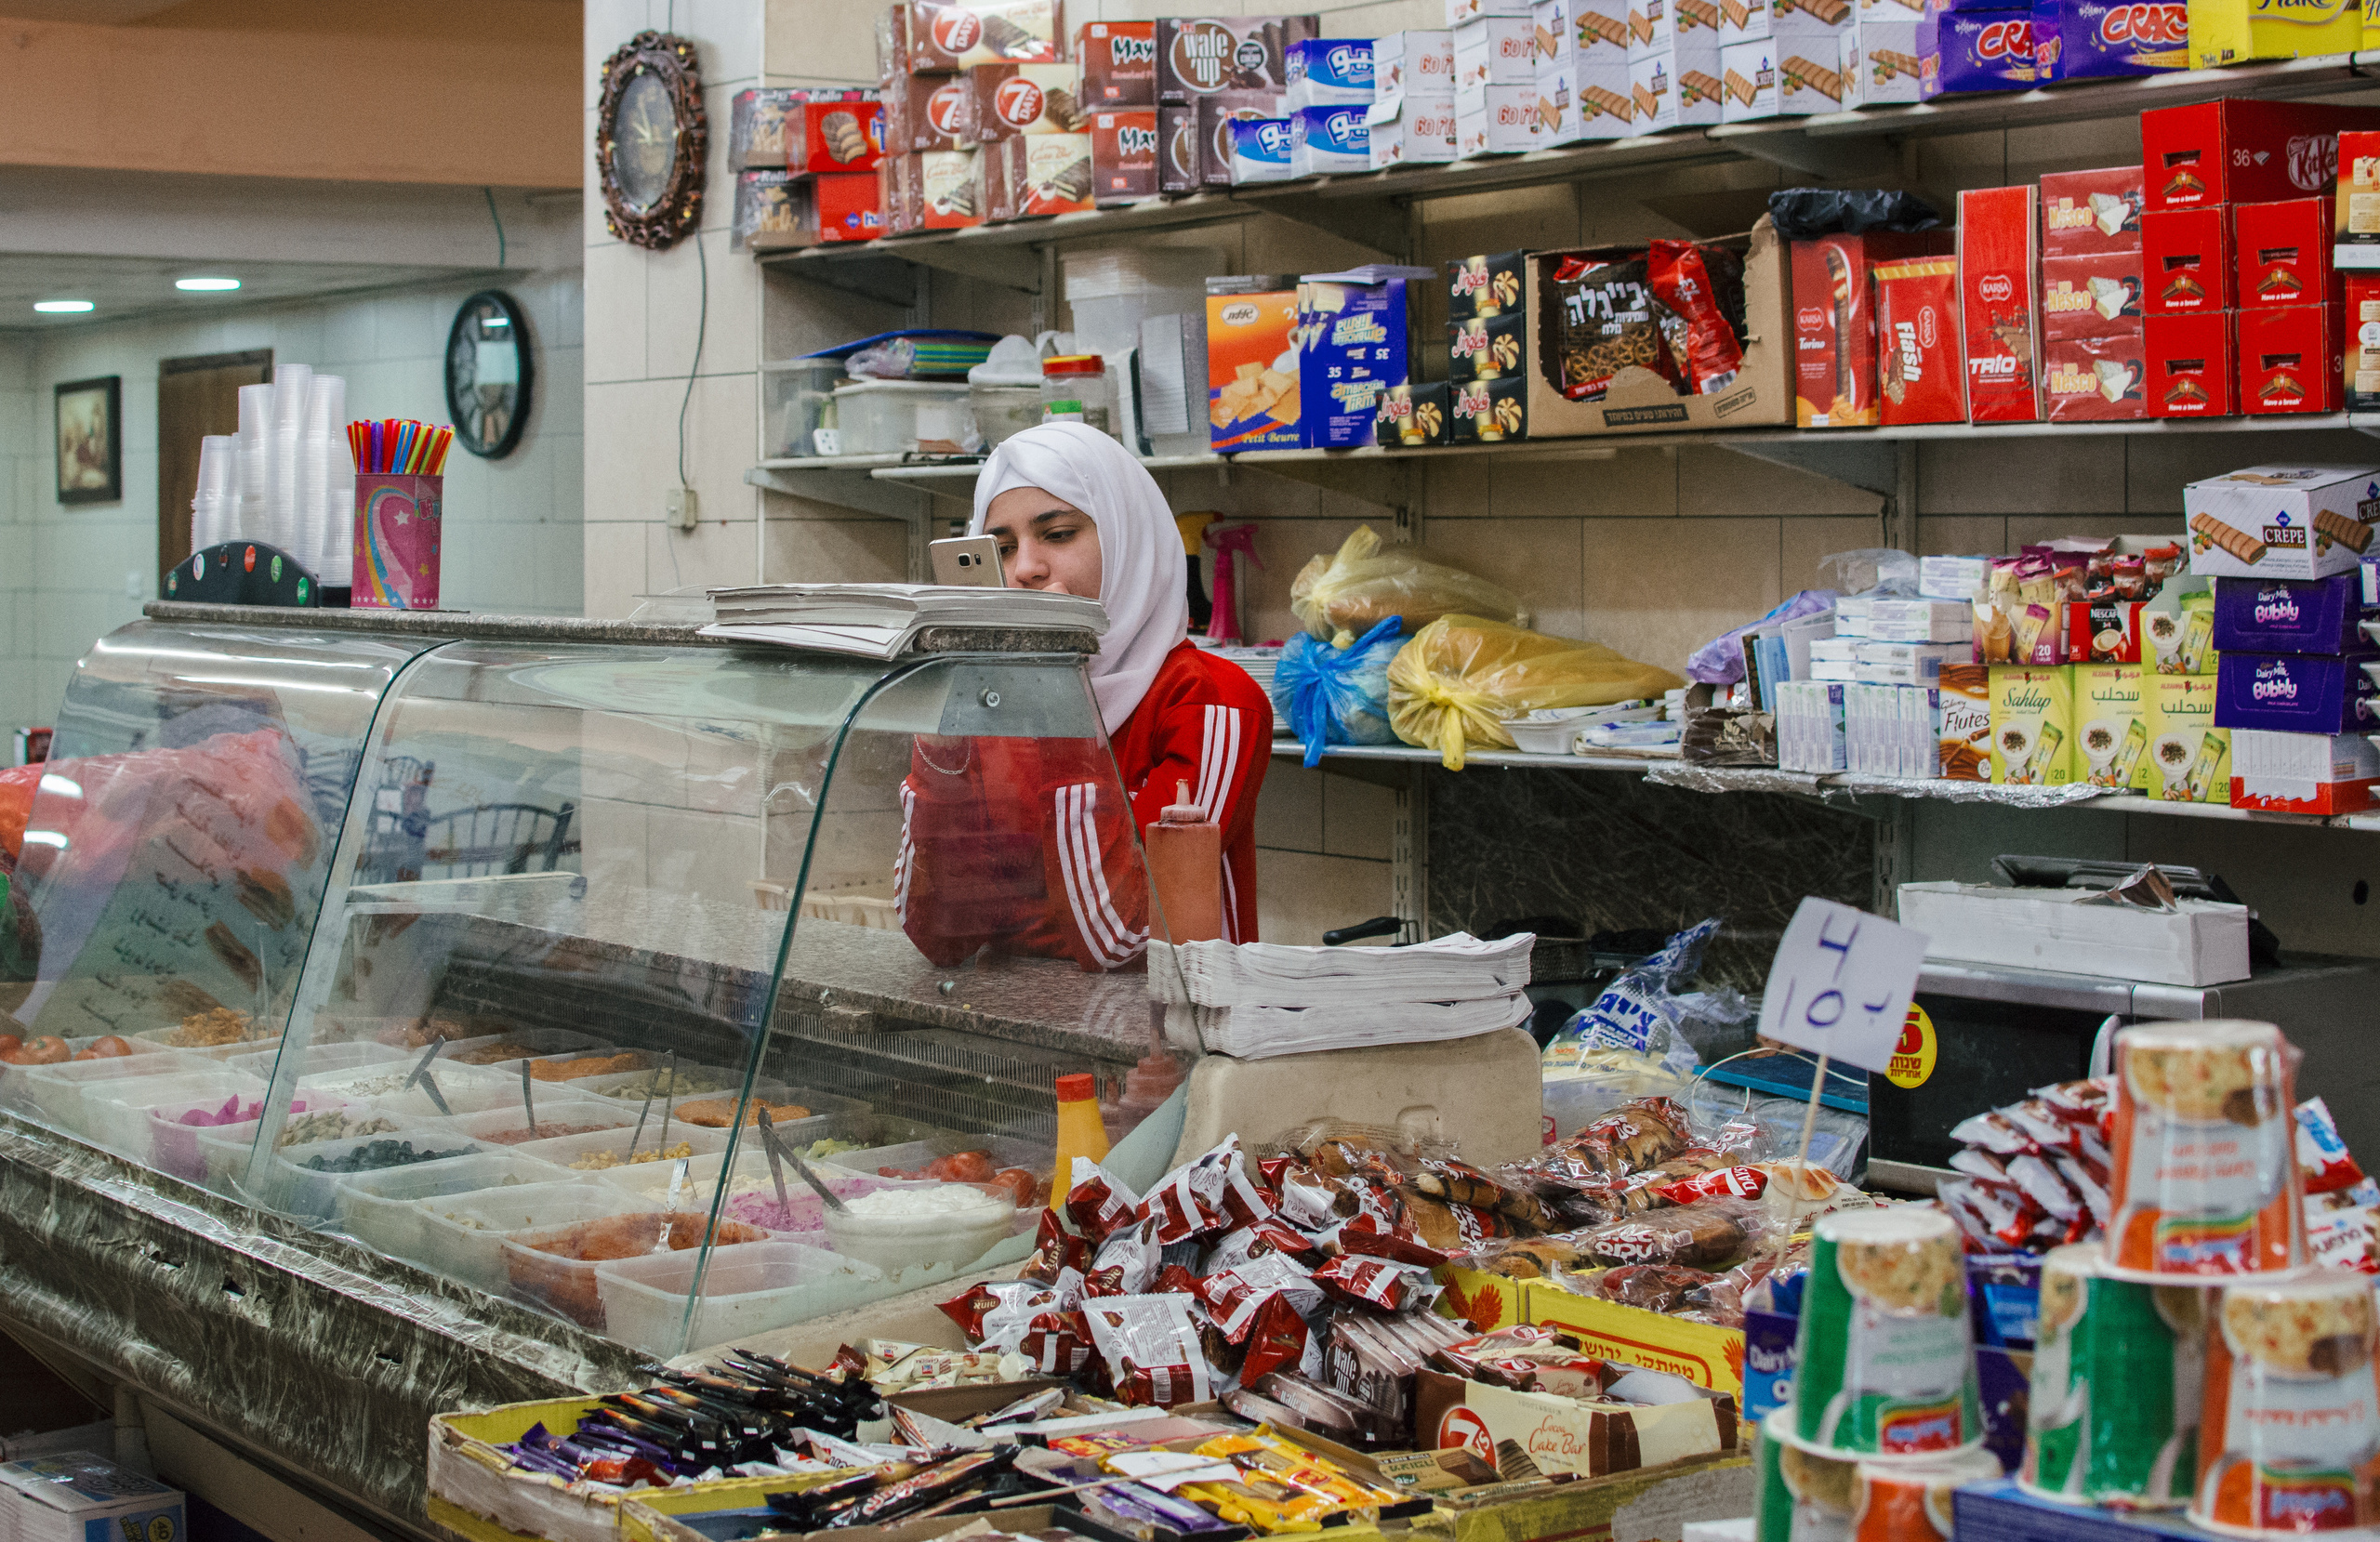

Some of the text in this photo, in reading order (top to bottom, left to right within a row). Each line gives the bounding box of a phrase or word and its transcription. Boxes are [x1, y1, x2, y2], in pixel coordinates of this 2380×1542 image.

[1977, 20, 2034, 60] CRA
[2233, 149, 2251, 166] 36
[2296, 138, 2338, 187] KitKa
[1566, 282, 1646, 326] בייגלה
[2047, 290, 2092, 312] Nesco
[2165, 300, 2181, 309] Have
[2187, 298, 2203, 307] break
[2261, 293, 2277, 301] Have
[2282, 291, 2298, 299] break
[1602, 324, 1622, 335] מלח
[1799, 337, 1826, 349] Torino
[1376, 349, 1390, 360] 35
[1895, 322, 1922, 382] Flash
[1328, 367, 1342, 377] 35
[2051, 371, 2096, 394] Nesco
[1242, 431, 1300, 443] Petit Beurre
[2359, 500, 2380, 521] CRE
[2265, 528, 2305, 544] CREPE
[2258, 591, 2275, 603] Dairy
[2091, 609, 2119, 618] NESCAF
[2254, 600, 2300, 624] Bubbly
[2038, 644, 2051, 656] 20
[2256, 665, 2289, 679] Dairy Milk
[2092, 687, 2139, 705] سحلب
[2253, 677, 2297, 699] Bubbly
[2003, 687, 2051, 714] Sahlap
[2161, 699, 2212, 718] سحلب
[1944, 711, 1990, 732] Flutes
[2055, 769, 2065, 780] 20
[2218, 782, 2228, 793] 20
[1890, 1056, 1922, 1070] שנות
[1890, 1069, 1922, 1079] אחריות
[1733, 1166, 1758, 1192] DAYS
[1577, 1337, 1621, 1360] ירוש
[1542, 1415, 1567, 1434] Cocoa
[1528, 1428, 1586, 1455] Cake Bar
